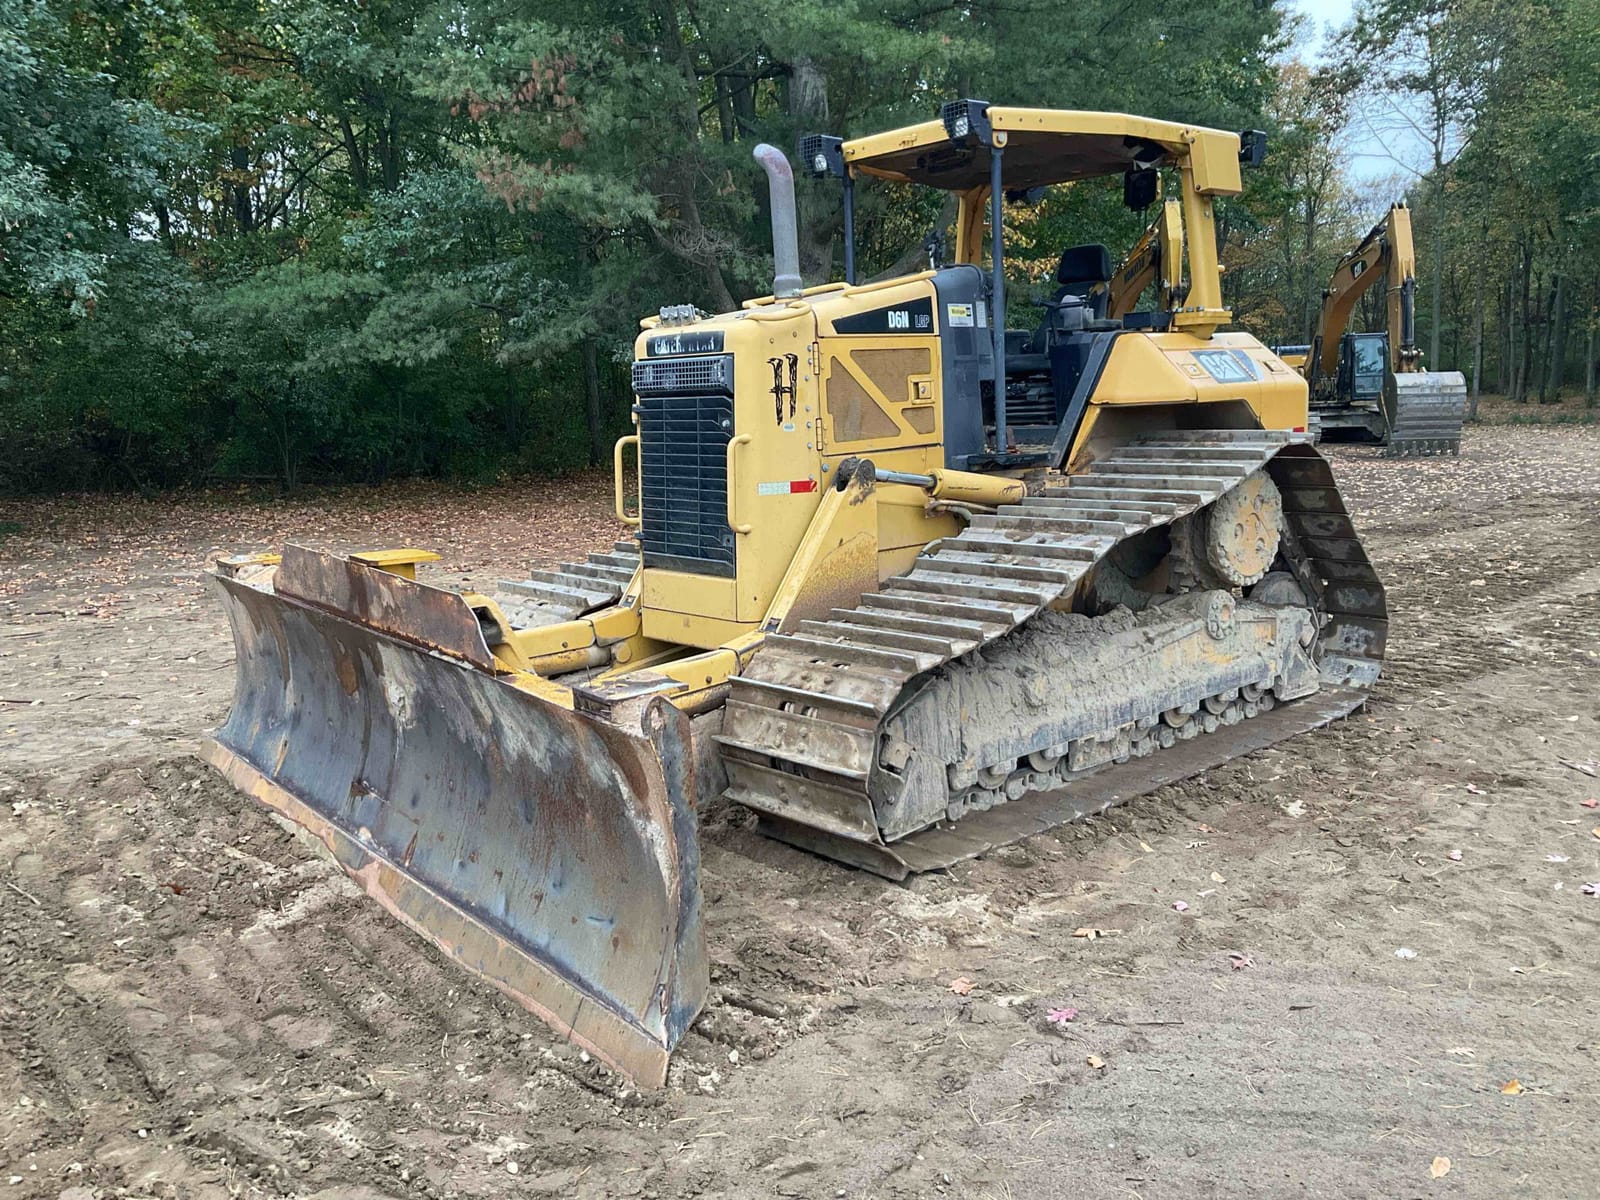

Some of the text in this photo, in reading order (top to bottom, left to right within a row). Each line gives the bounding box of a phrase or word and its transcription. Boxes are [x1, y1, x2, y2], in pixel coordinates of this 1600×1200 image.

[888, 310, 930, 328] D6N LGP
[1199, 353, 1247, 379] CAT
